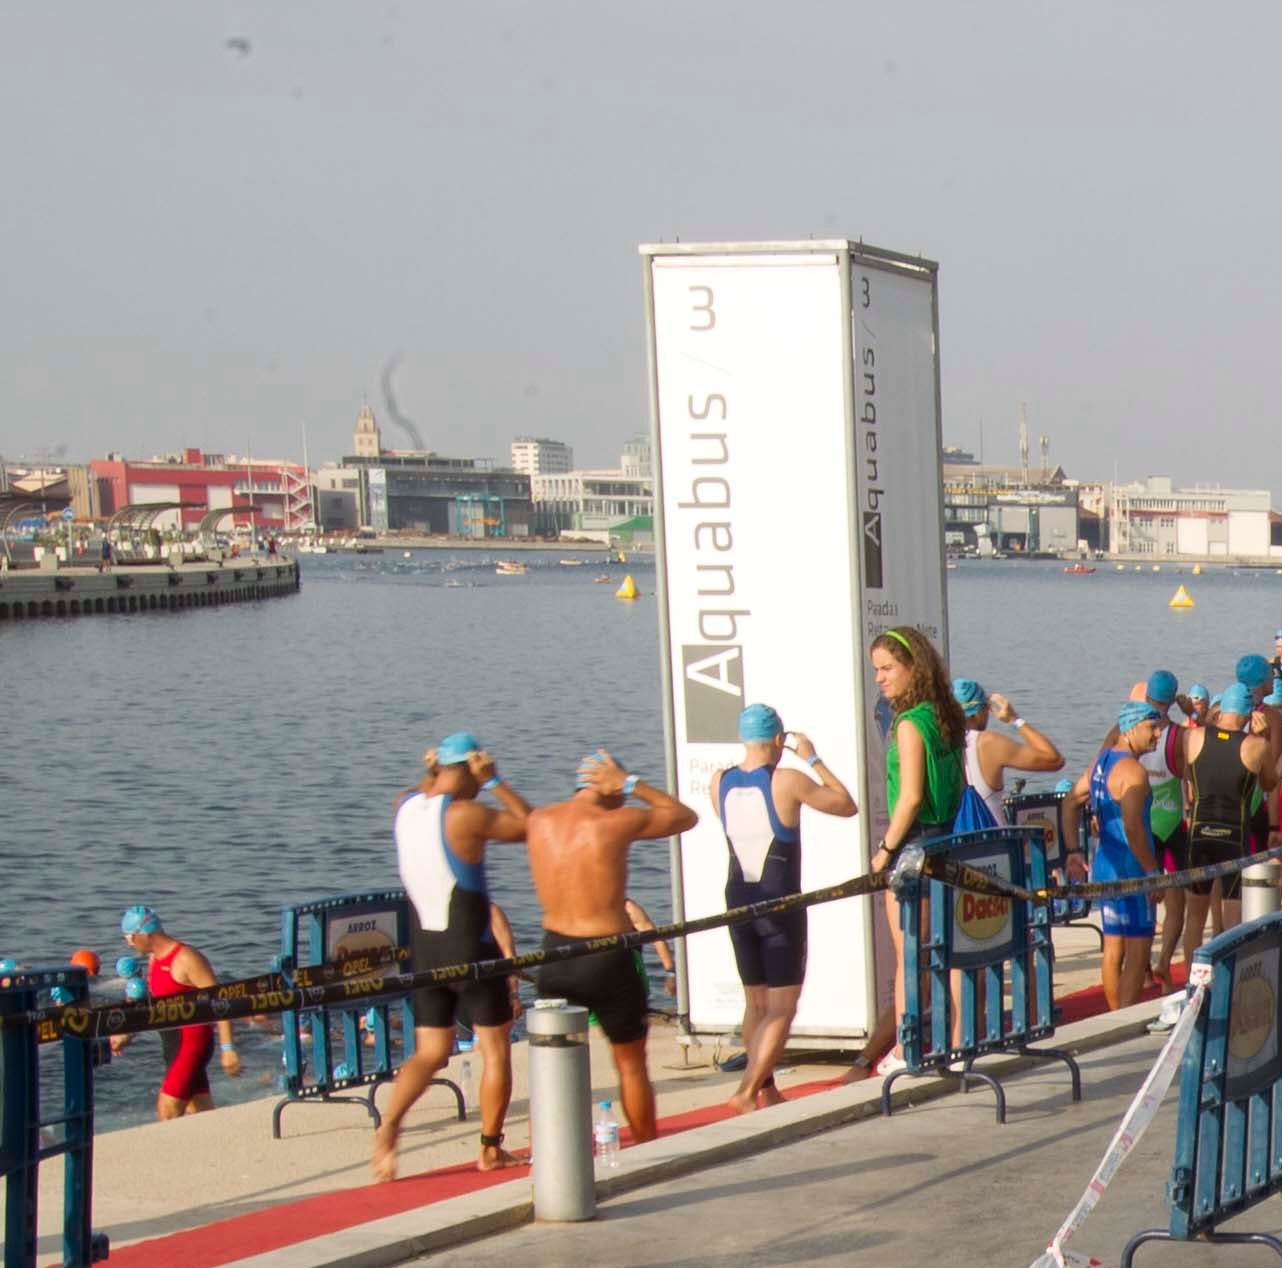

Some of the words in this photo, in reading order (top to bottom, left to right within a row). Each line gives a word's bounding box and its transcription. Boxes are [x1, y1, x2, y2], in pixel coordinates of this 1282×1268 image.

[689, 285, 717, 331] 3
[861, 277, 871, 309] 3
[861, 347, 885, 546] Aquabus
[678, 393, 751, 696] Aquabus
